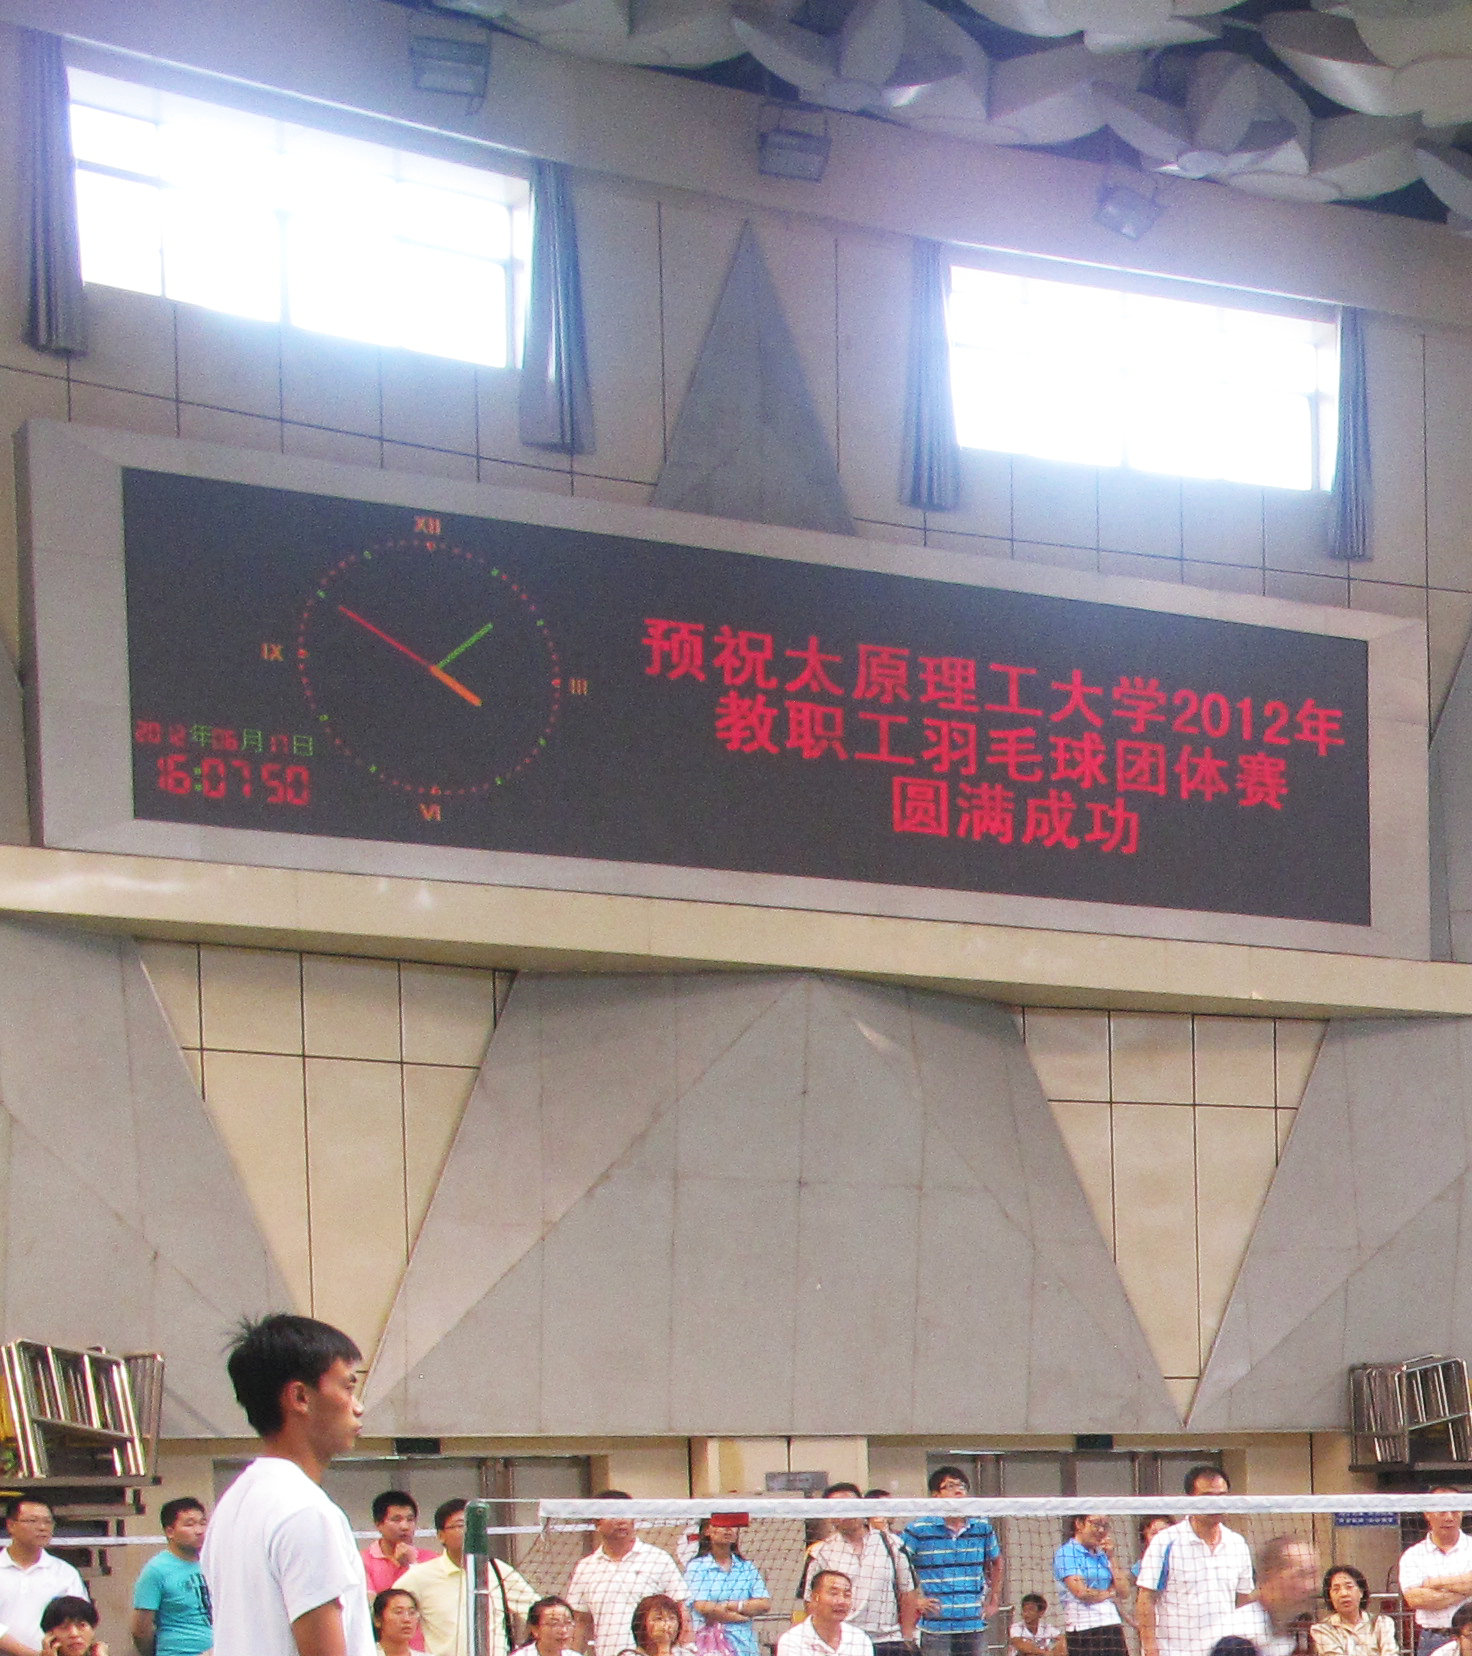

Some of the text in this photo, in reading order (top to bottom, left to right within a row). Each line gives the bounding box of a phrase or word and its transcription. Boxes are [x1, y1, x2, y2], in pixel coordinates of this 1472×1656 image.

[642, 617, 1346, 756] 预祝太原理工大学2012年
[714, 690, 1290, 809] 教职工羽毛球团体赛
[891, 776, 1140, 855] 圆满成功
